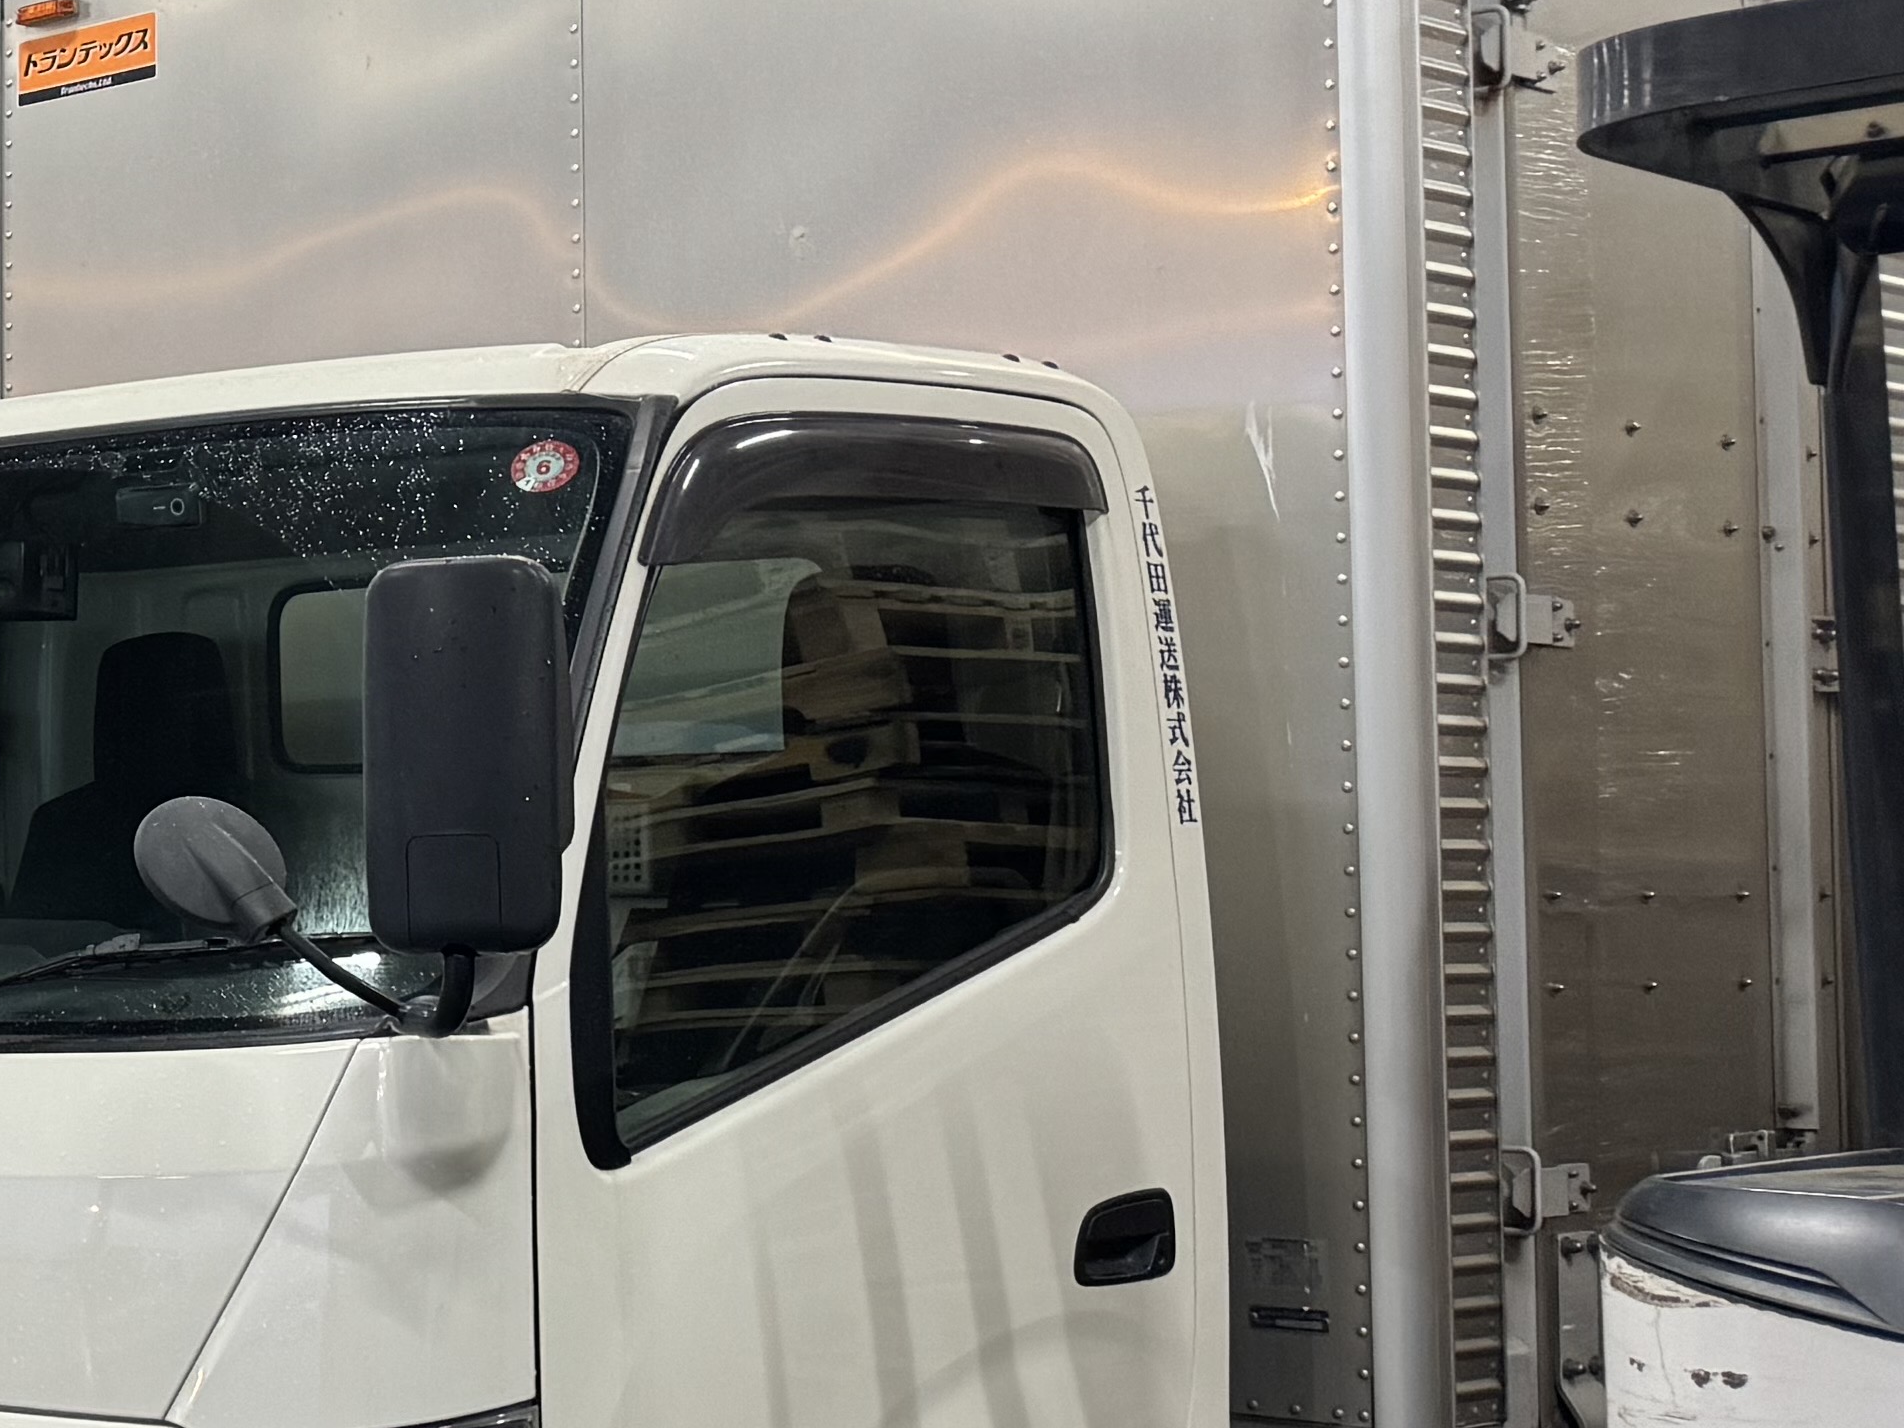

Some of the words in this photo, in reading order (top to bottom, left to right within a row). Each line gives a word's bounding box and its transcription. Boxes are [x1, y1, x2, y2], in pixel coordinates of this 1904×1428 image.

[23, 27, 150, 78] トランテックス
[536, 460, 552, 475] 6
[1134, 485, 1198, 825] 千代田運送株式会社
